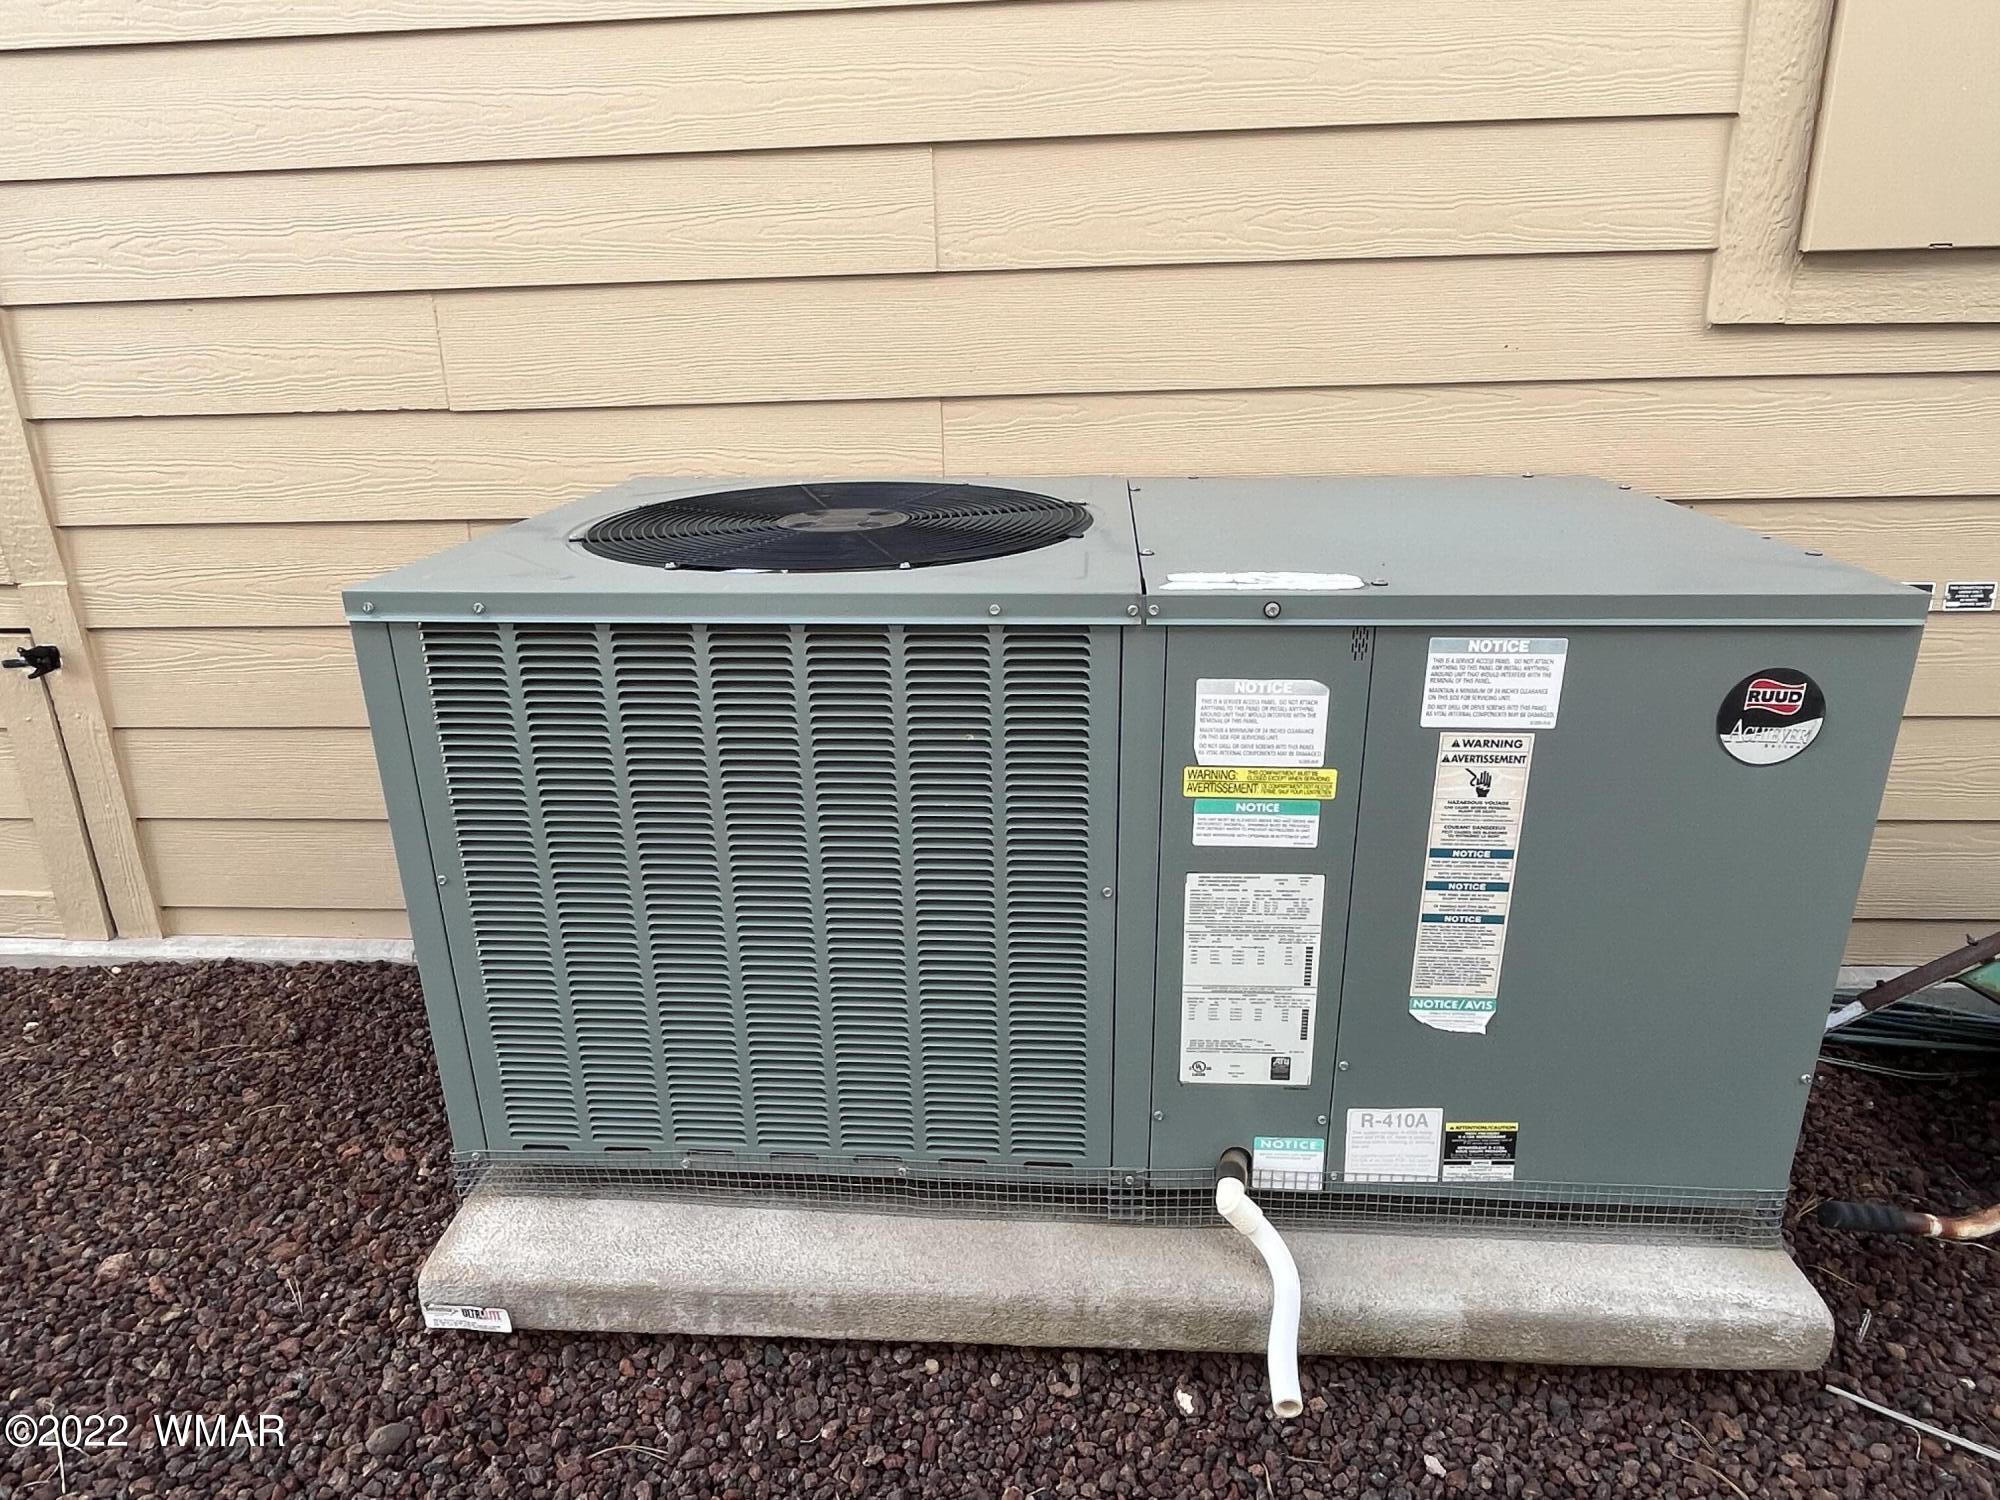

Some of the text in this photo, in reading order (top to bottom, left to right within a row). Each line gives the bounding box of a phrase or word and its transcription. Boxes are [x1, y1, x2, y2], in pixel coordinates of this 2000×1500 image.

[1468, 640, 1531, 652] NOTICE
[1234, 682, 1293, 694] NOTICE
[1748, 690, 1803, 703] RUUD
[1463, 740, 1523, 748] WARNING
[1452, 754, 1526, 764] AVERTISSEMENT
[1236, 804, 1280, 812] NOTICE
[1452, 850, 1491, 858] NOTICE
[1448, 883, 1486, 891] NOTICE
[1444, 916, 1482, 924] NOTICE
[1413, 1000, 1493, 1010] NOTICE/AVIS
[1361, 1113, 1429, 1128] R-410A
[1261, 1140, 1317, 1150] NOTICE
